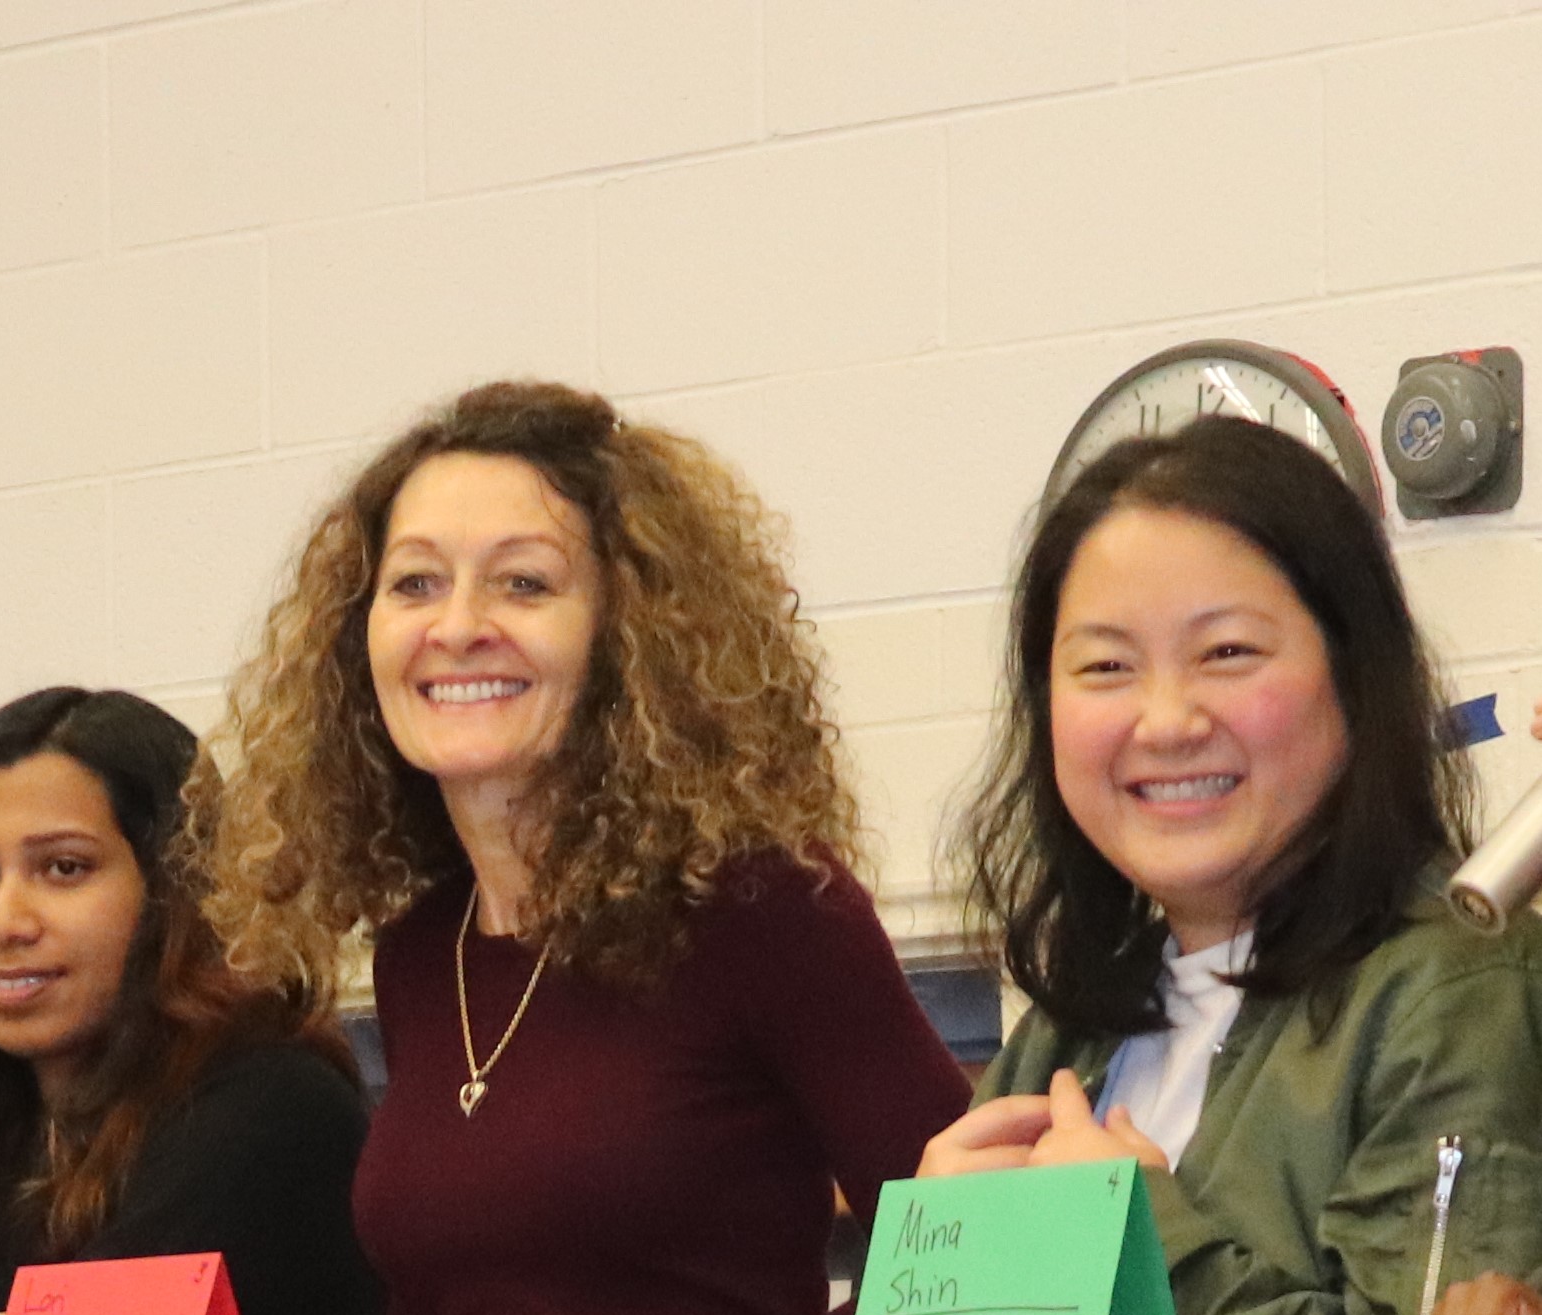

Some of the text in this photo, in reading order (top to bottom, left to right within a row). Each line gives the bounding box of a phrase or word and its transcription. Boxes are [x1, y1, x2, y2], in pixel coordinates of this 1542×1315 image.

[1107, 1167, 1120, 1196] 4
[893, 1199, 963, 1258] Mina
[886, 1269, 958, 1314] Shin
